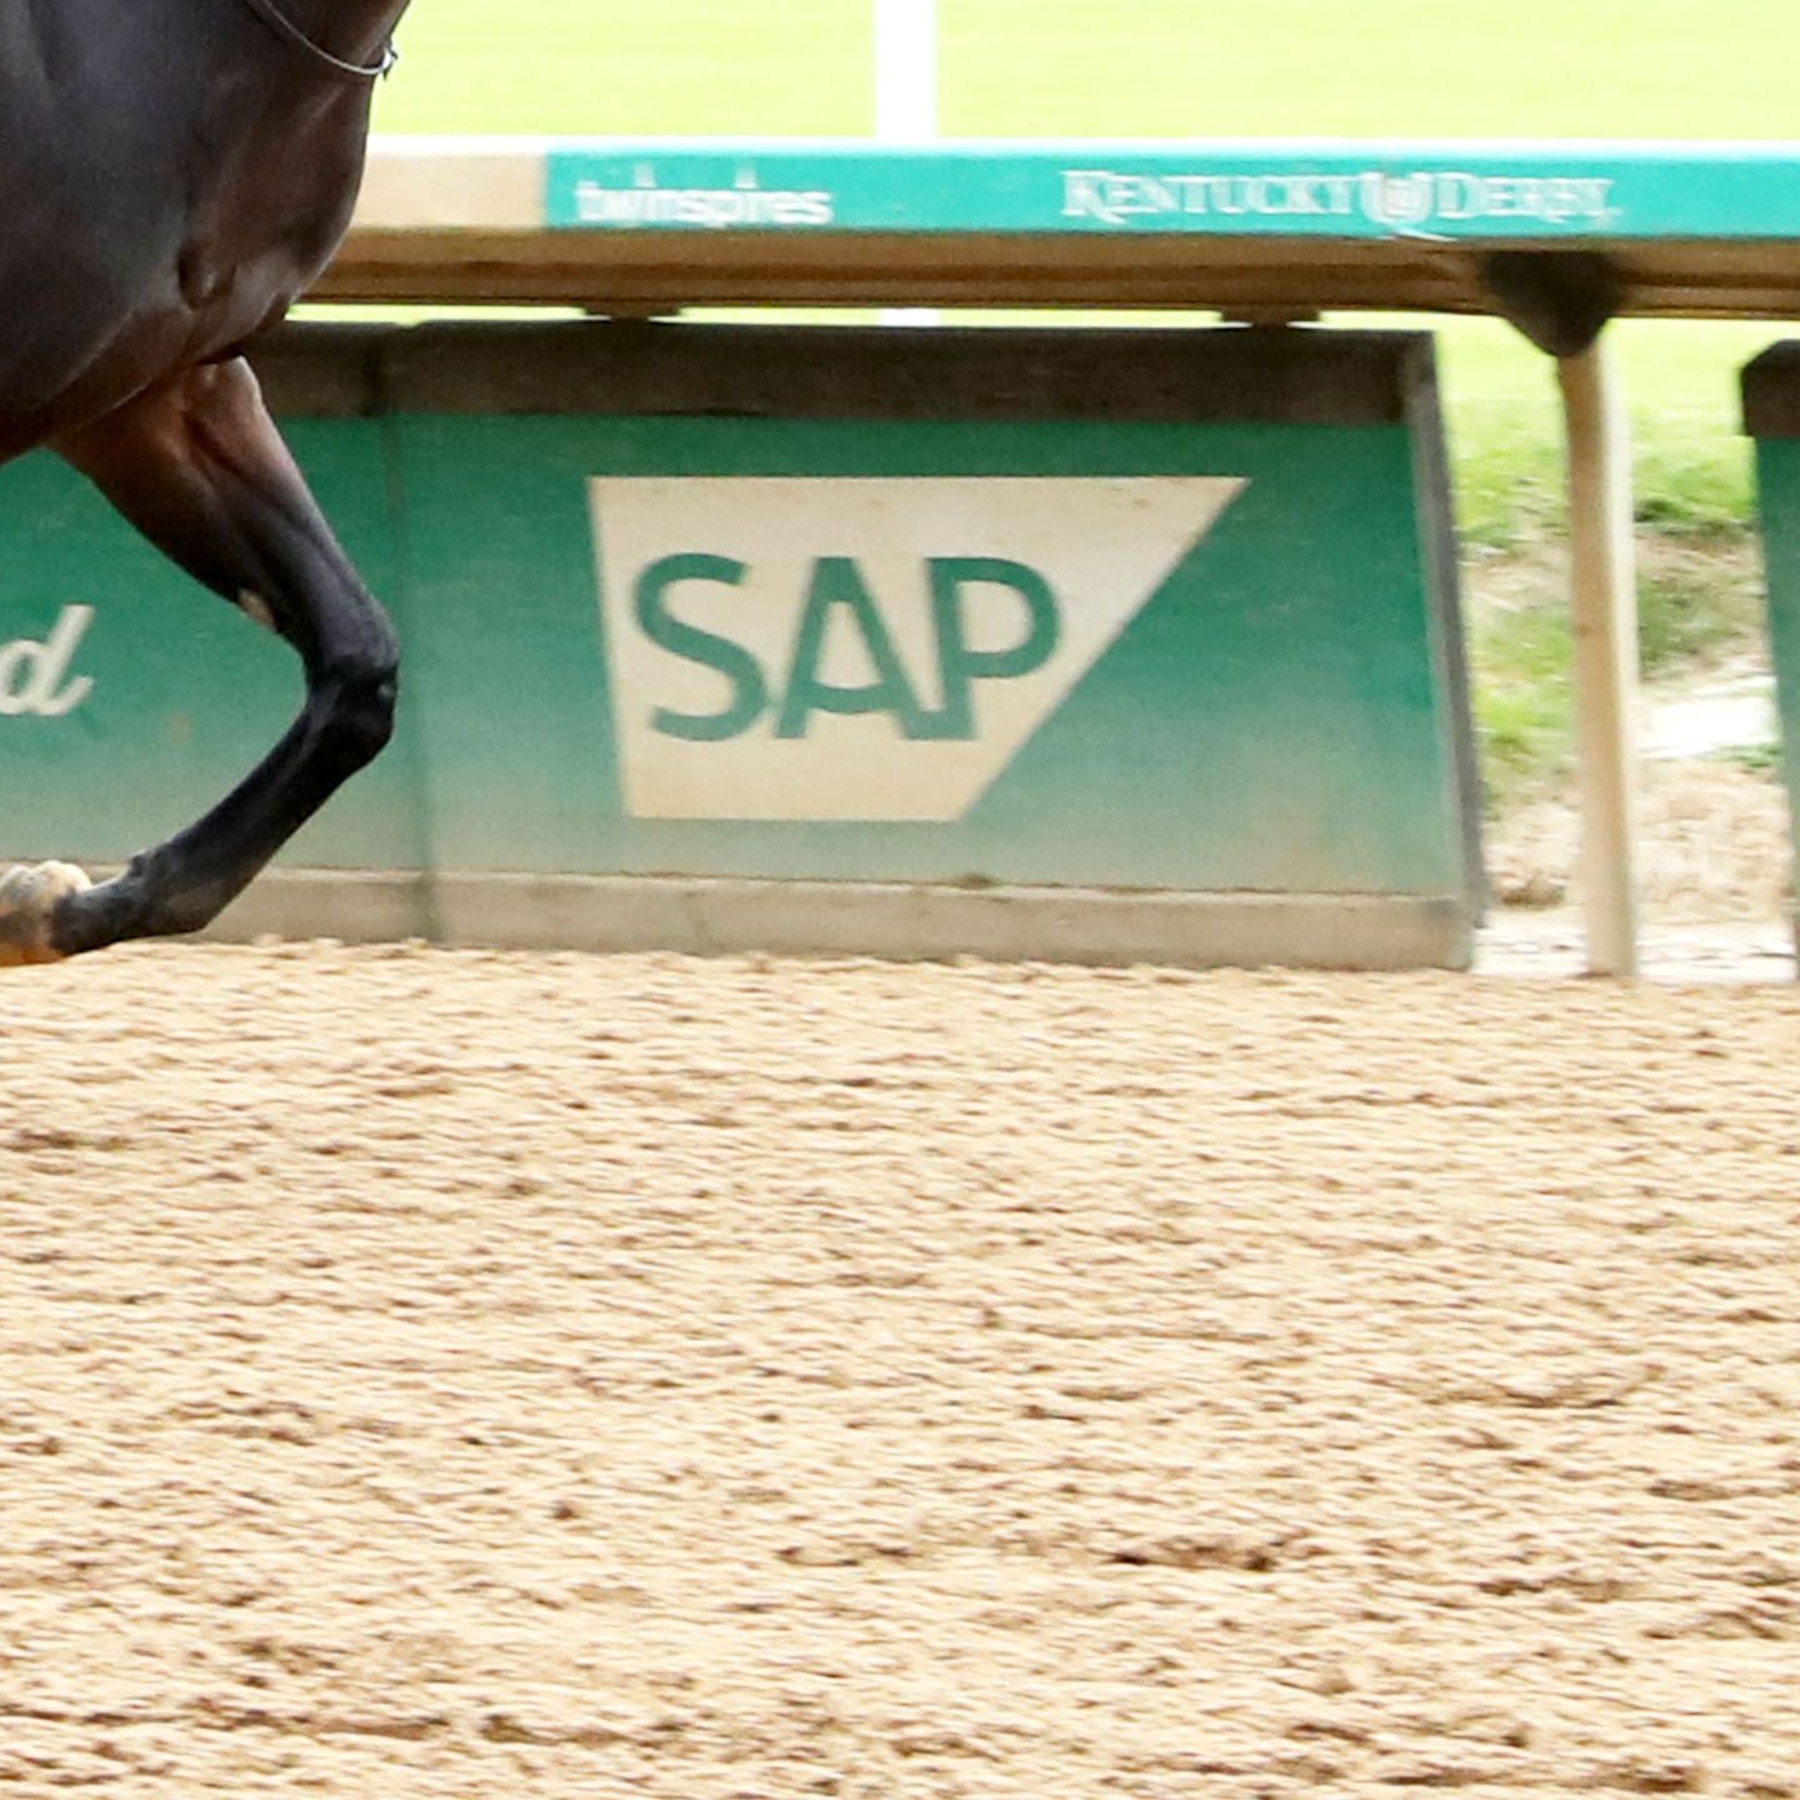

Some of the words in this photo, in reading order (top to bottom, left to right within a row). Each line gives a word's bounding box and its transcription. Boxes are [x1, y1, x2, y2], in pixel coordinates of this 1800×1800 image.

[574, 163, 834, 228] twinspires
[1060, 170, 1359, 224] KENTUCKY
[1437, 172, 1618, 226] DERBY
[632, 552, 1061, 743] SAP
